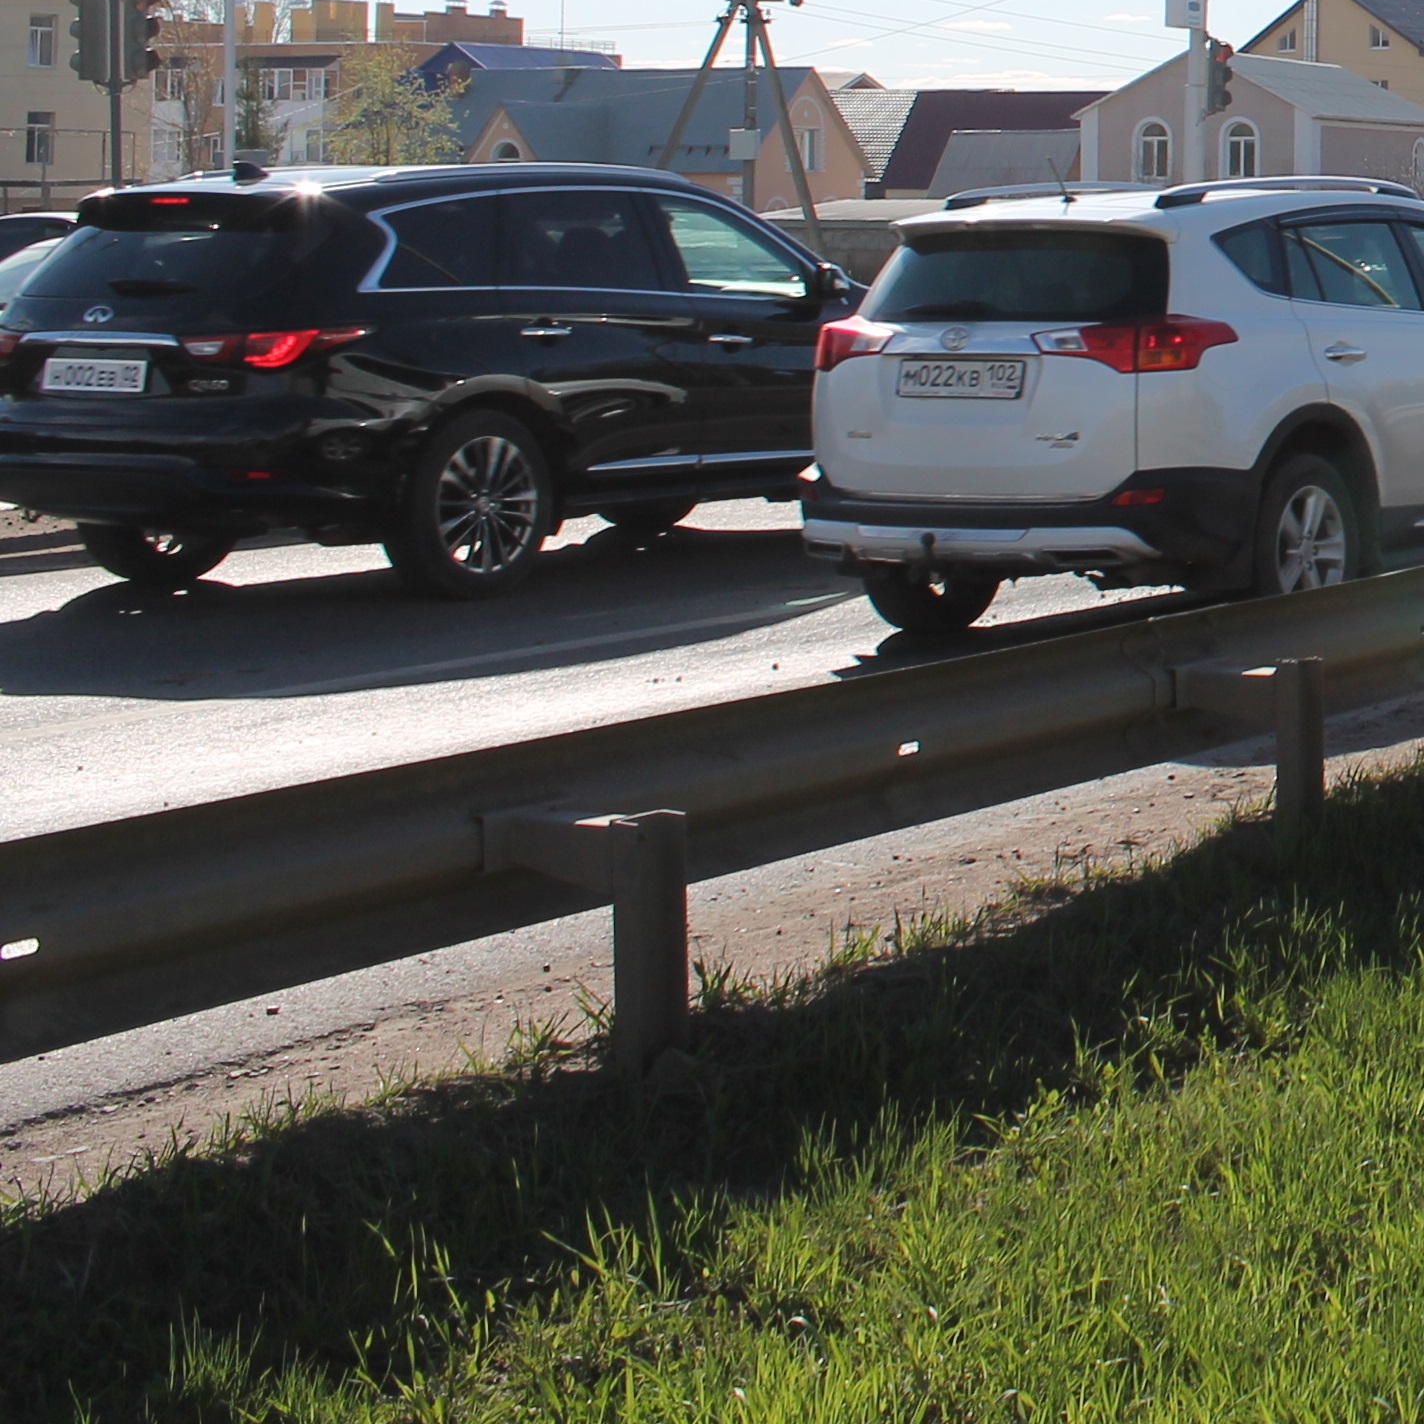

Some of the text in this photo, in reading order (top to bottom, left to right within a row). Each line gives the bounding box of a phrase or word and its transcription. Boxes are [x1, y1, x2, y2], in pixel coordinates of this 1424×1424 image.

[122, 366, 139, 382] 02
[903, 364, 1017, 387] М022КВ 102
